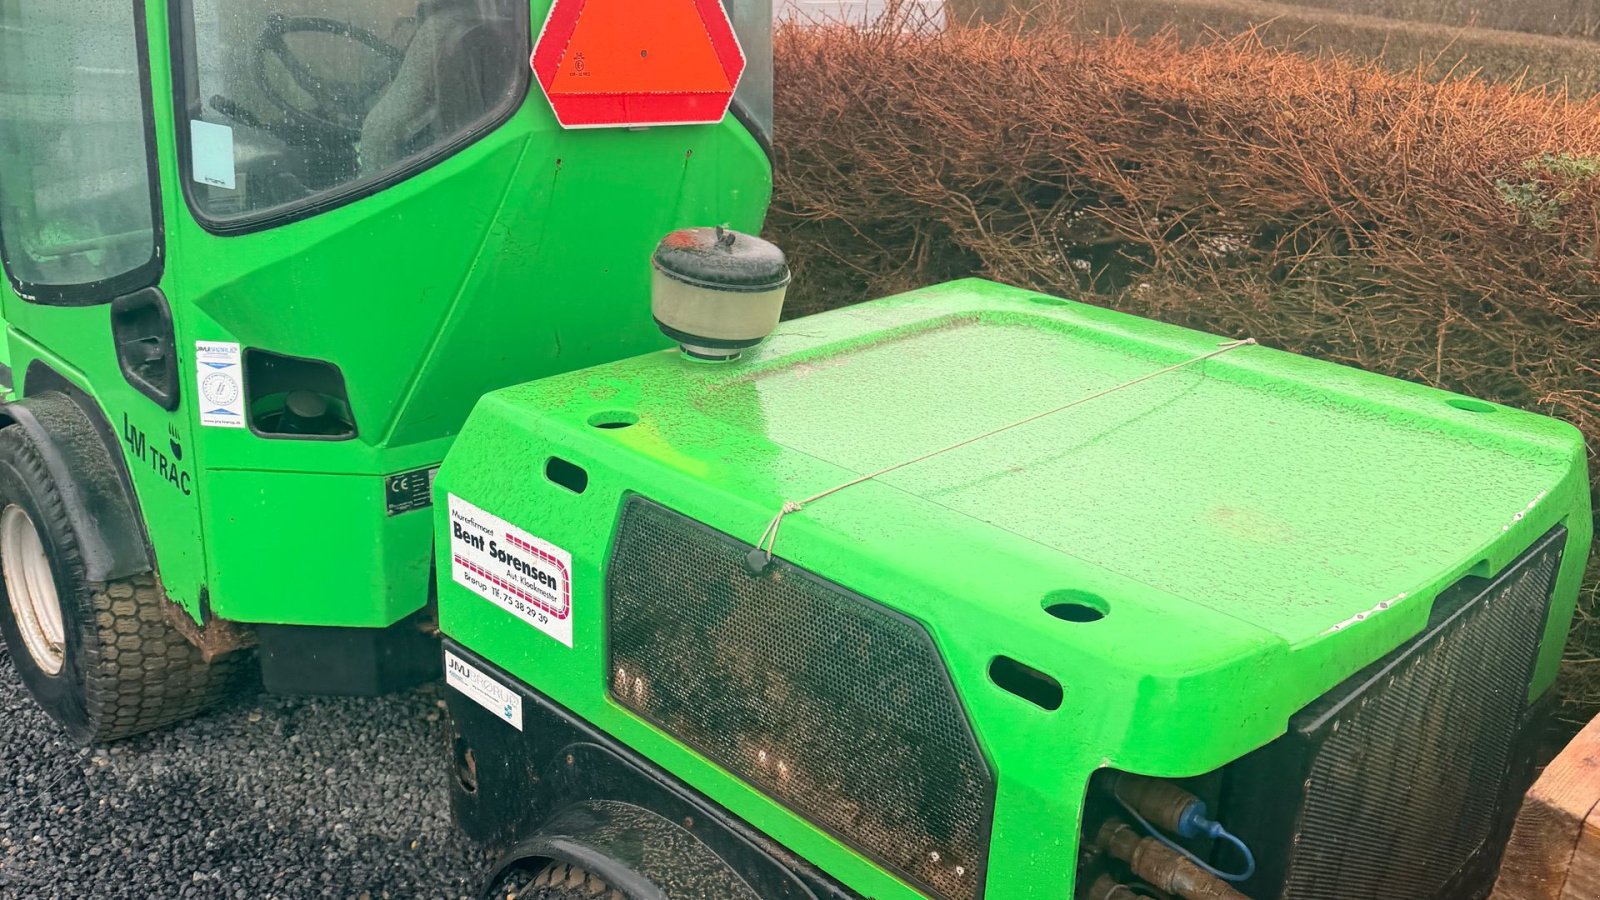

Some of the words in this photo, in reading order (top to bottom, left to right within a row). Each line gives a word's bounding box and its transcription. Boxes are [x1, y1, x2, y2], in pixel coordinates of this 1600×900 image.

[123, 411, 146, 463] LM
[149, 445, 191, 496] TRAC
[391, 477, 408, 492] CE
[453, 520, 485, 551] Bent
[489, 540, 557, 590] Sørensen
[506, 569, 519, 582] Aut.
[464, 571, 488, 592] Brørup
[491, 586, 502, 600] Tlf.
[503, 593, 513, 605] 75
[514, 599, 525, 612] 38
[526, 605, 537, 618] 29
[538, 611, 549, 625] 39
